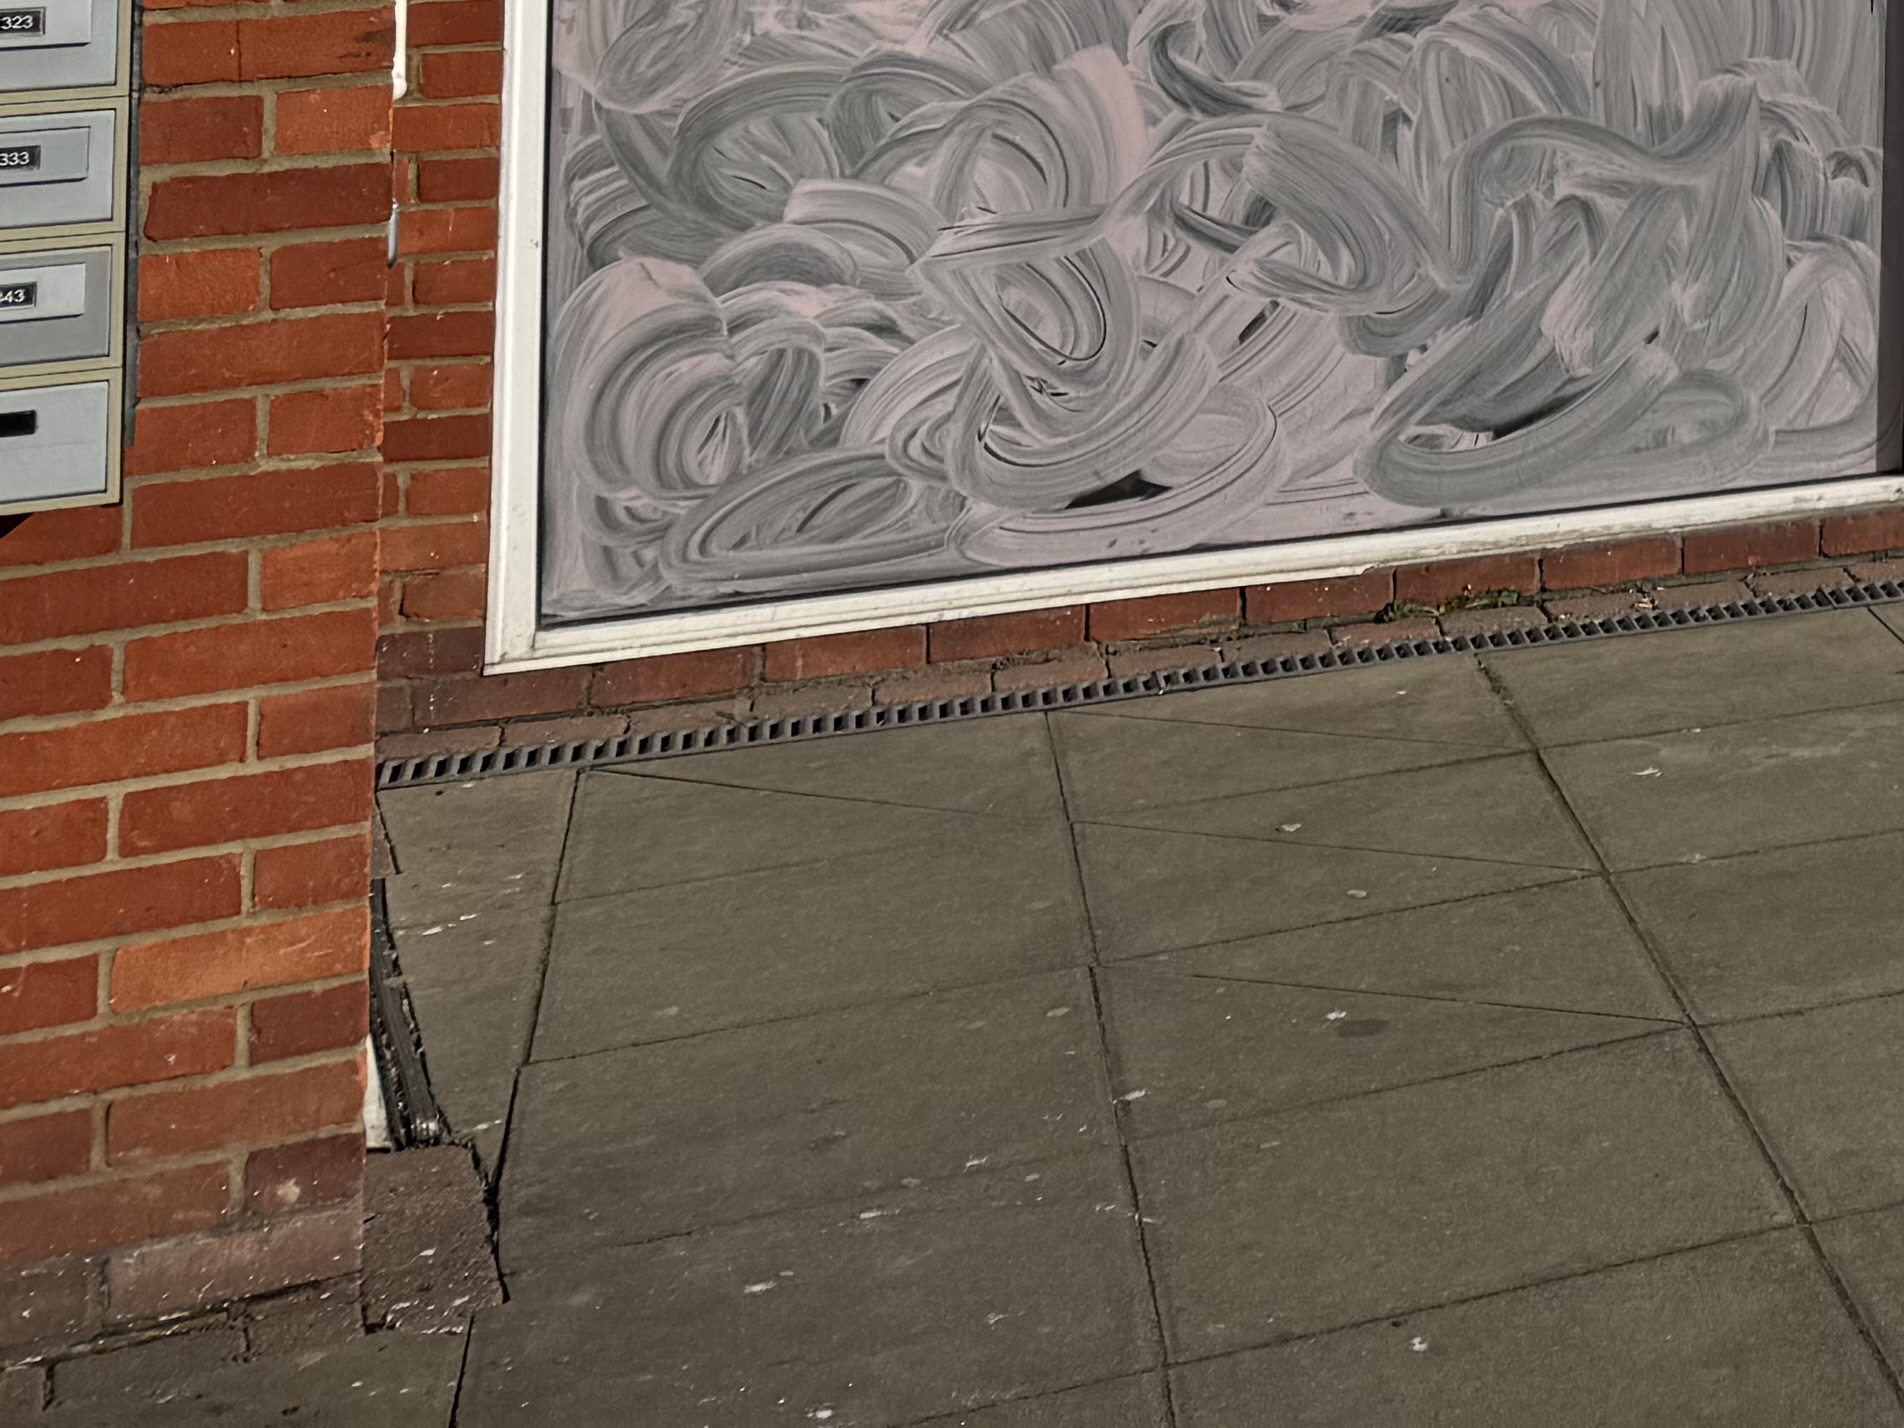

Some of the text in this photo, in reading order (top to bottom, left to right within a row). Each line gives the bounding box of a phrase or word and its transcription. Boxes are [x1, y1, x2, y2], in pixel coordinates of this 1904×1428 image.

[1, 13, 34, 31] 323
[0, 150, 30, 167] 333
[0, 288, 26, 304] 43
